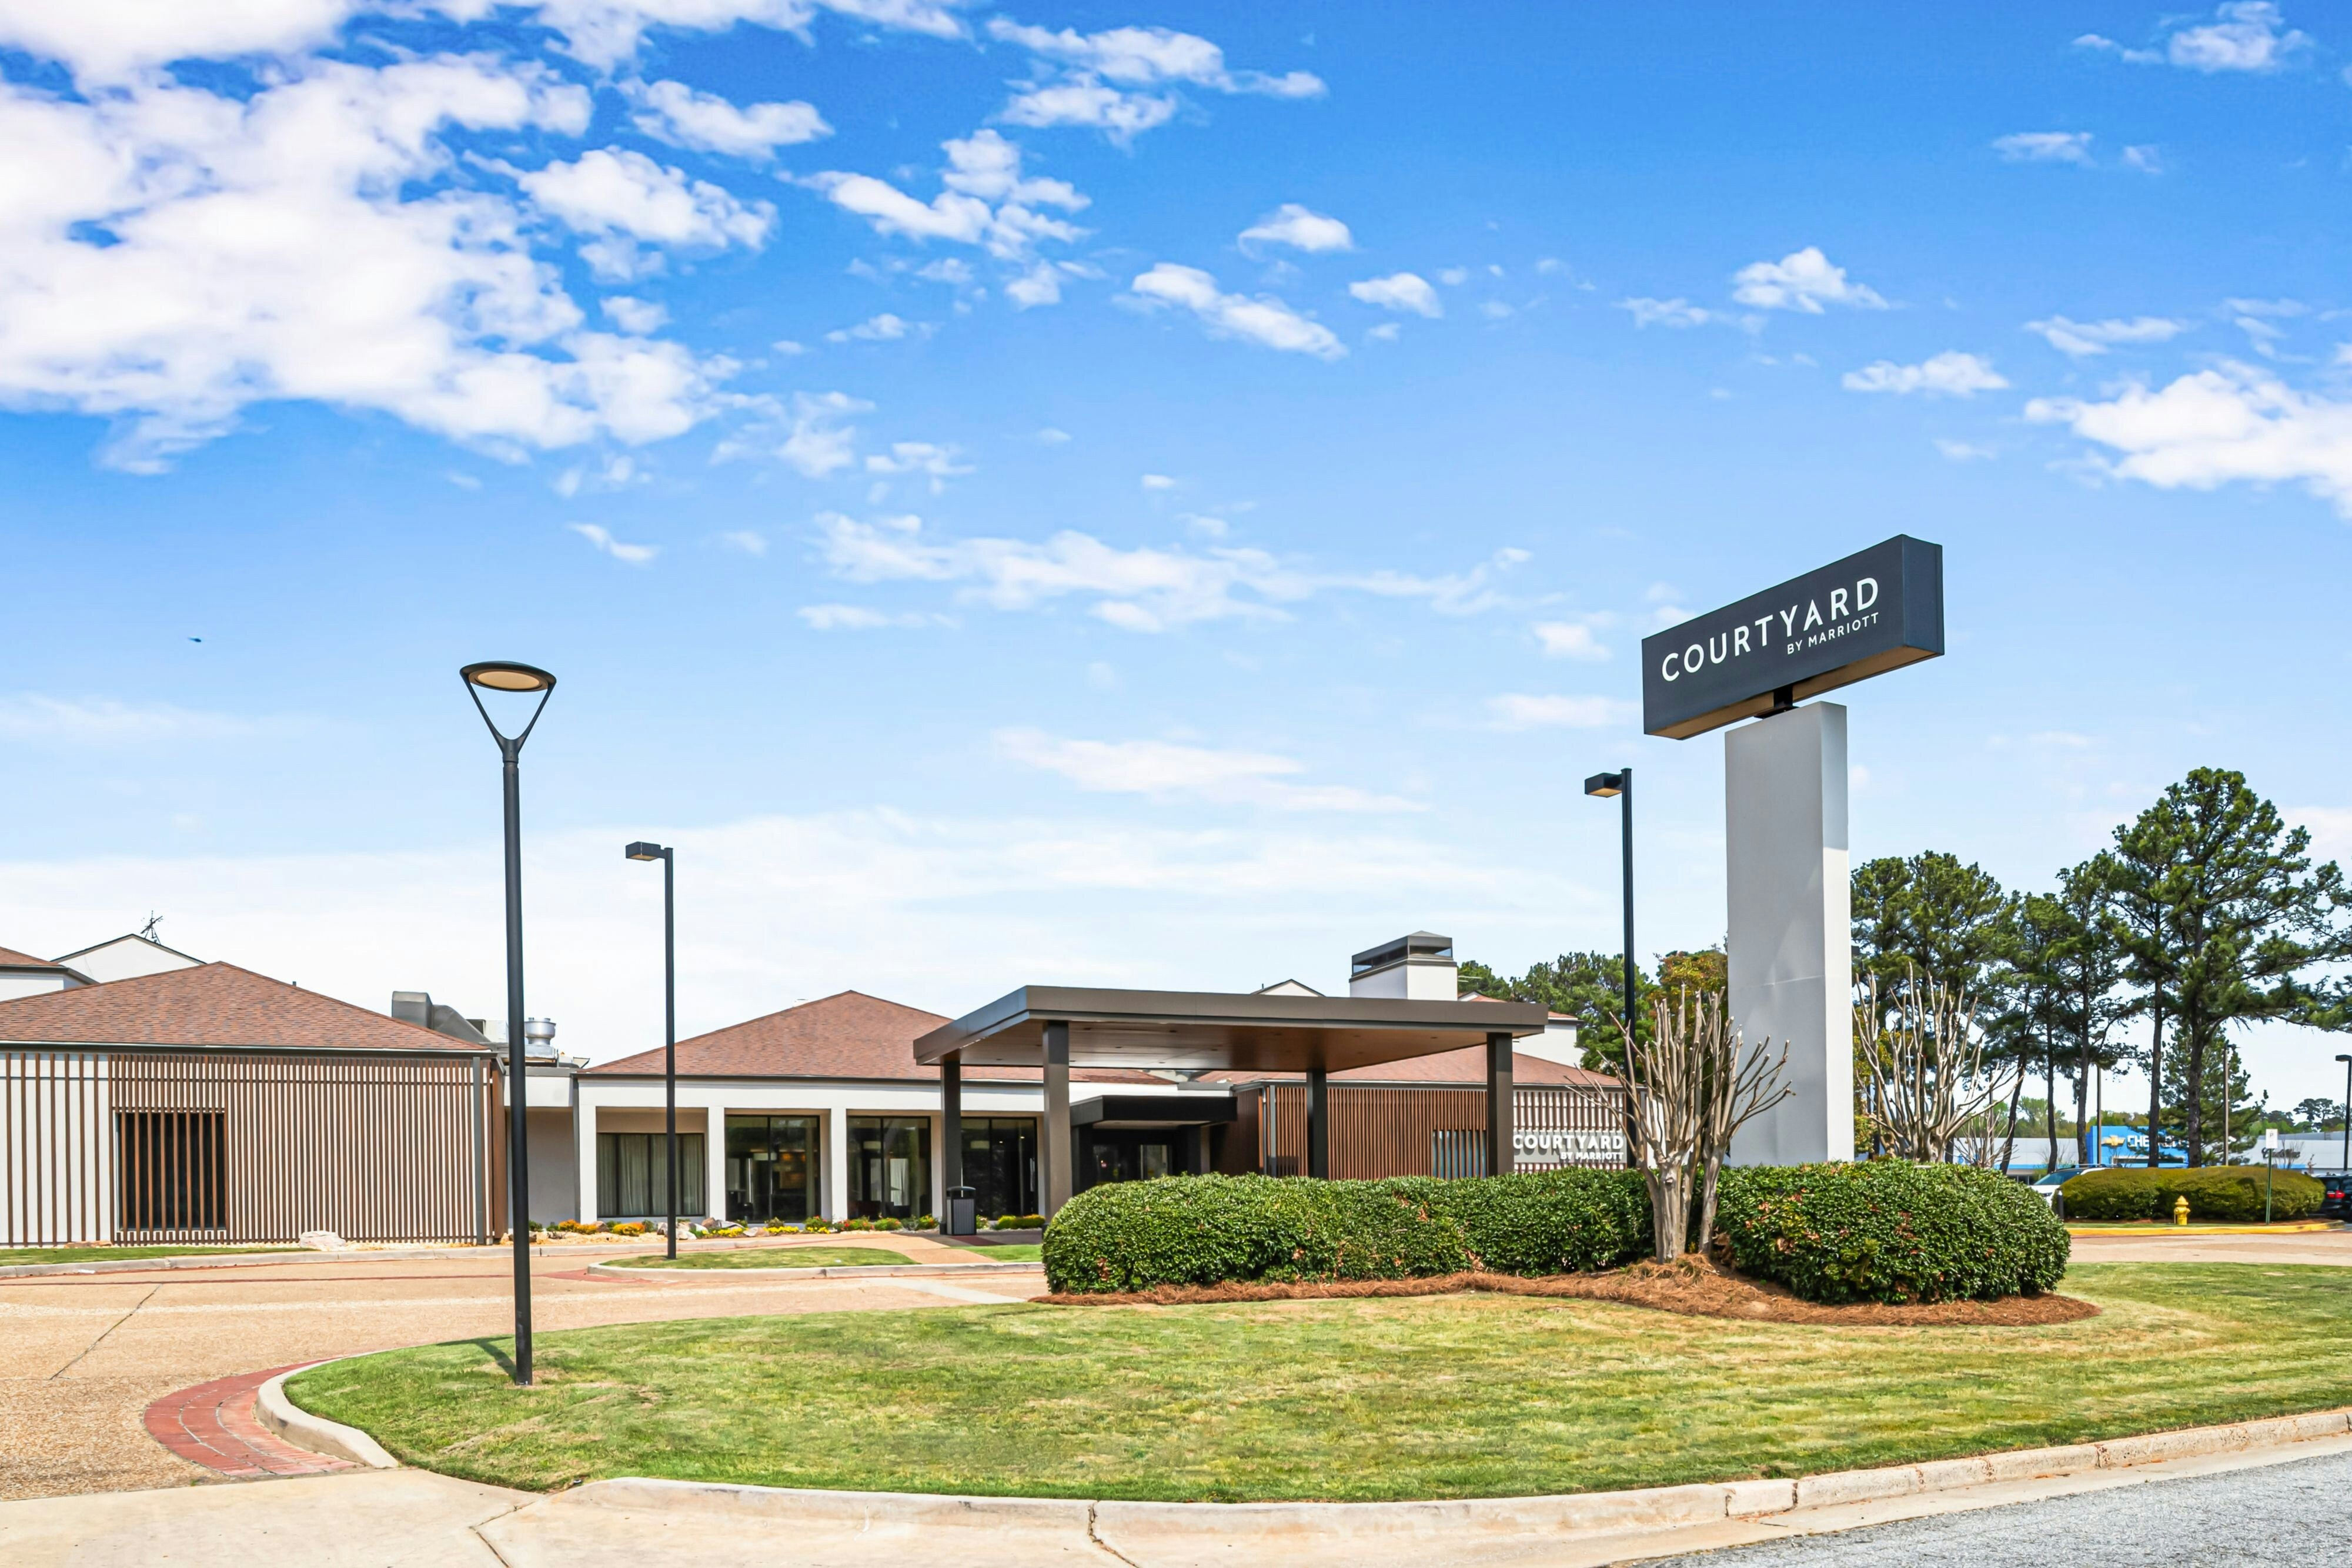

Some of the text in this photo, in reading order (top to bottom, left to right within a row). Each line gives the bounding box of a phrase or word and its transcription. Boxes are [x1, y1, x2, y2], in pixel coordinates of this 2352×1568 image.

[1662, 577, 1879, 681] COURTYARD
[1787, 612, 1879, 655] BY MARRIOTT
[1513, 1134, 1623, 1149] COURTYARD
[1560, 1152, 1623, 1161] BY MARRIOTT
